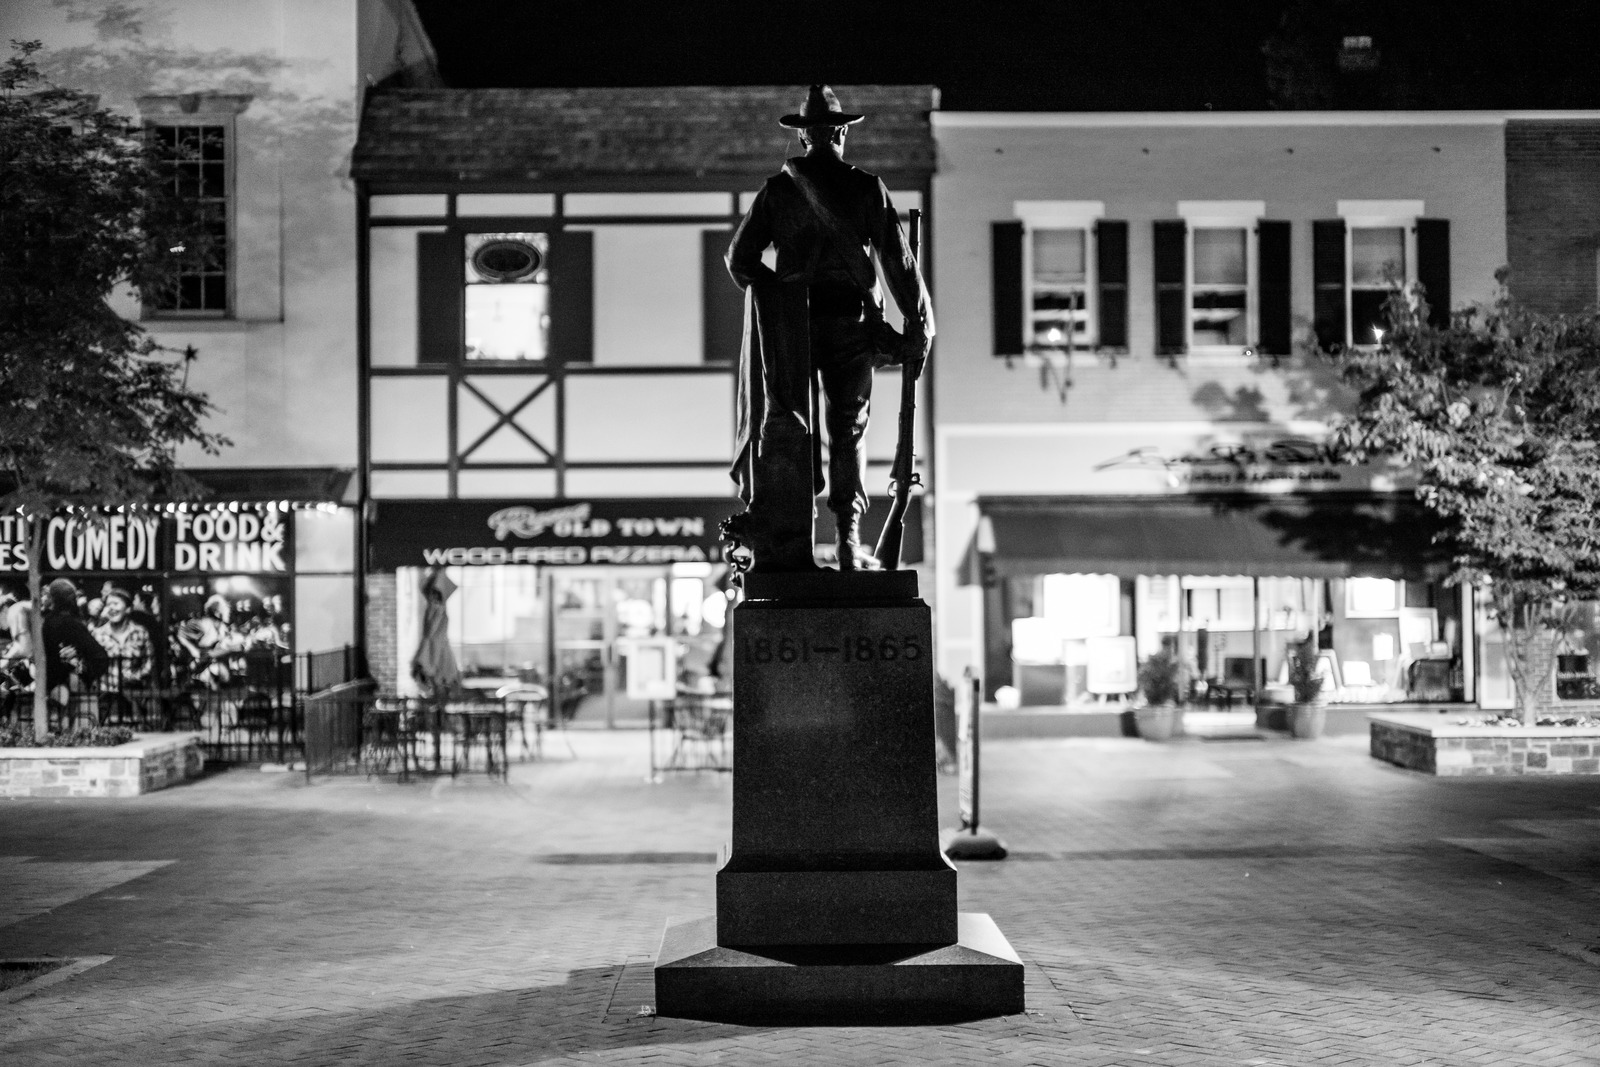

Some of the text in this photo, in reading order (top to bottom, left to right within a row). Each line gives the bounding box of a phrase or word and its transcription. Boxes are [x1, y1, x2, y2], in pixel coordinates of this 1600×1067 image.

[553, 517, 611, 538] OLD
[617, 517, 704, 537] TOWN
[47, 515, 159, 571] COMEDY
[175, 541, 286, 571] DRINK
